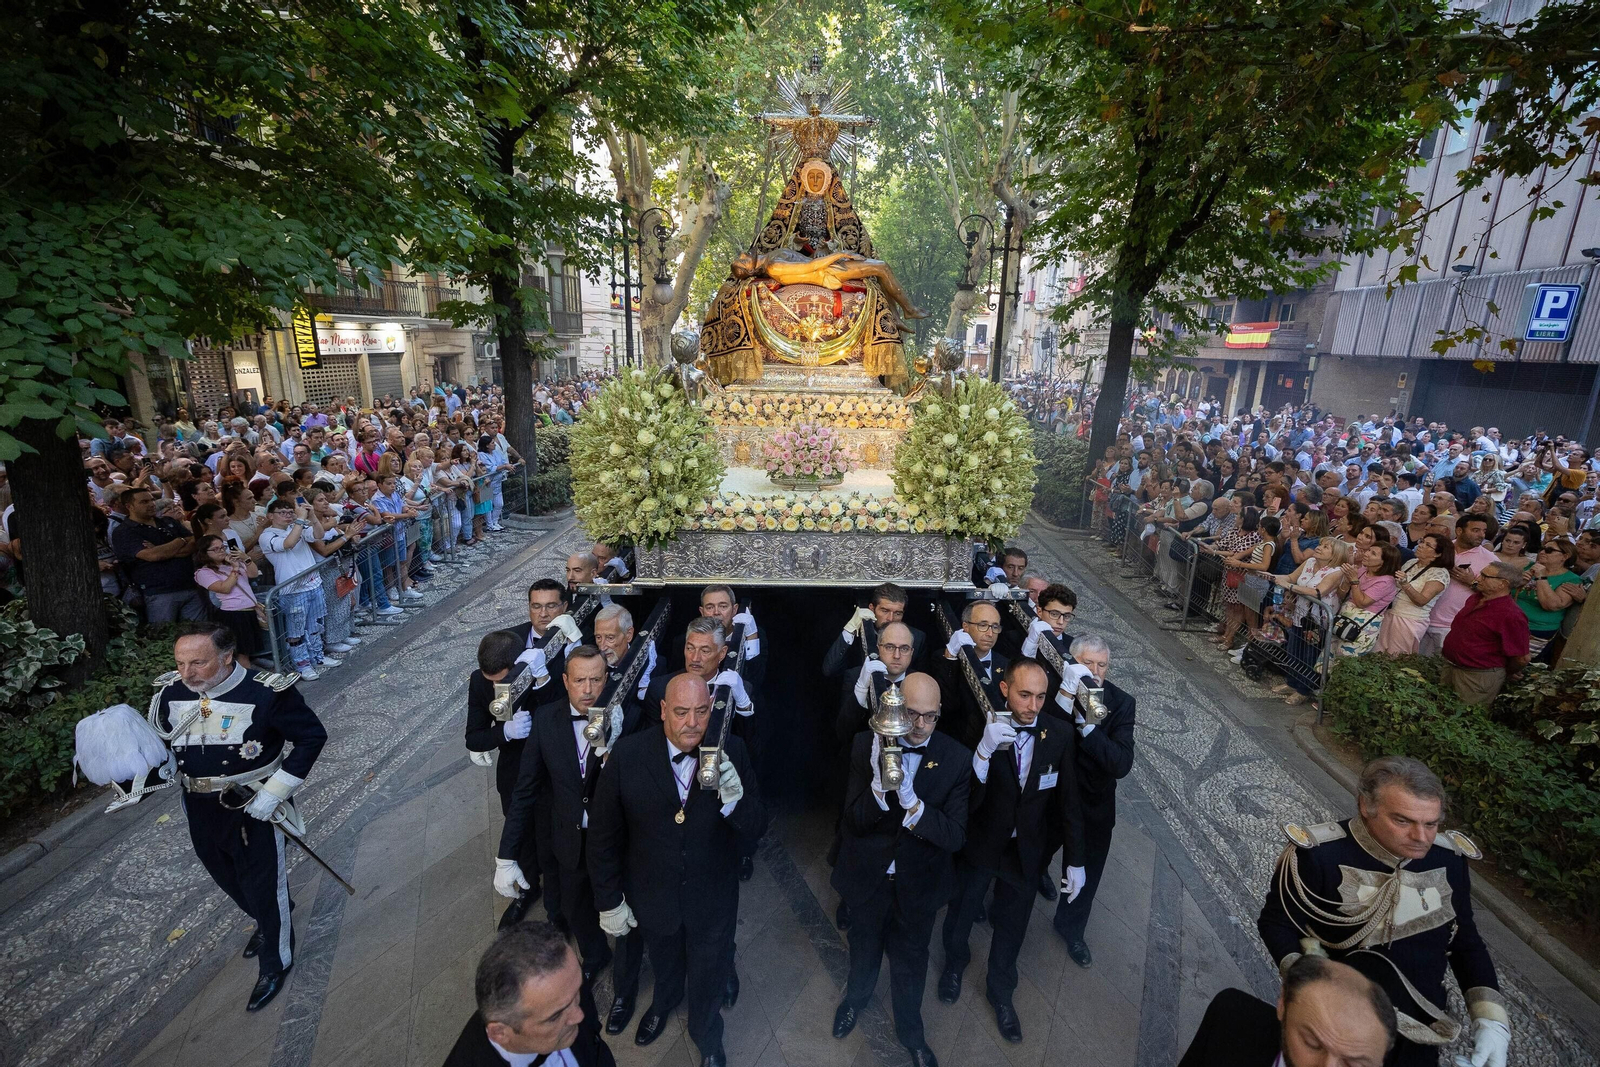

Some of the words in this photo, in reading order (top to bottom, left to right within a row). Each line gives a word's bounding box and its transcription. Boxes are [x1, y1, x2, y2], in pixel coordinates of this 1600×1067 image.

[1540, 291, 1569, 318] P
[292, 306, 318, 368] ZZERIA
[318, 336, 329, 345] iao
[330, 333, 360, 346] Mamma
[361, 333, 378, 346] Rosa
[234, 367, 260, 375] ONZALEZ
